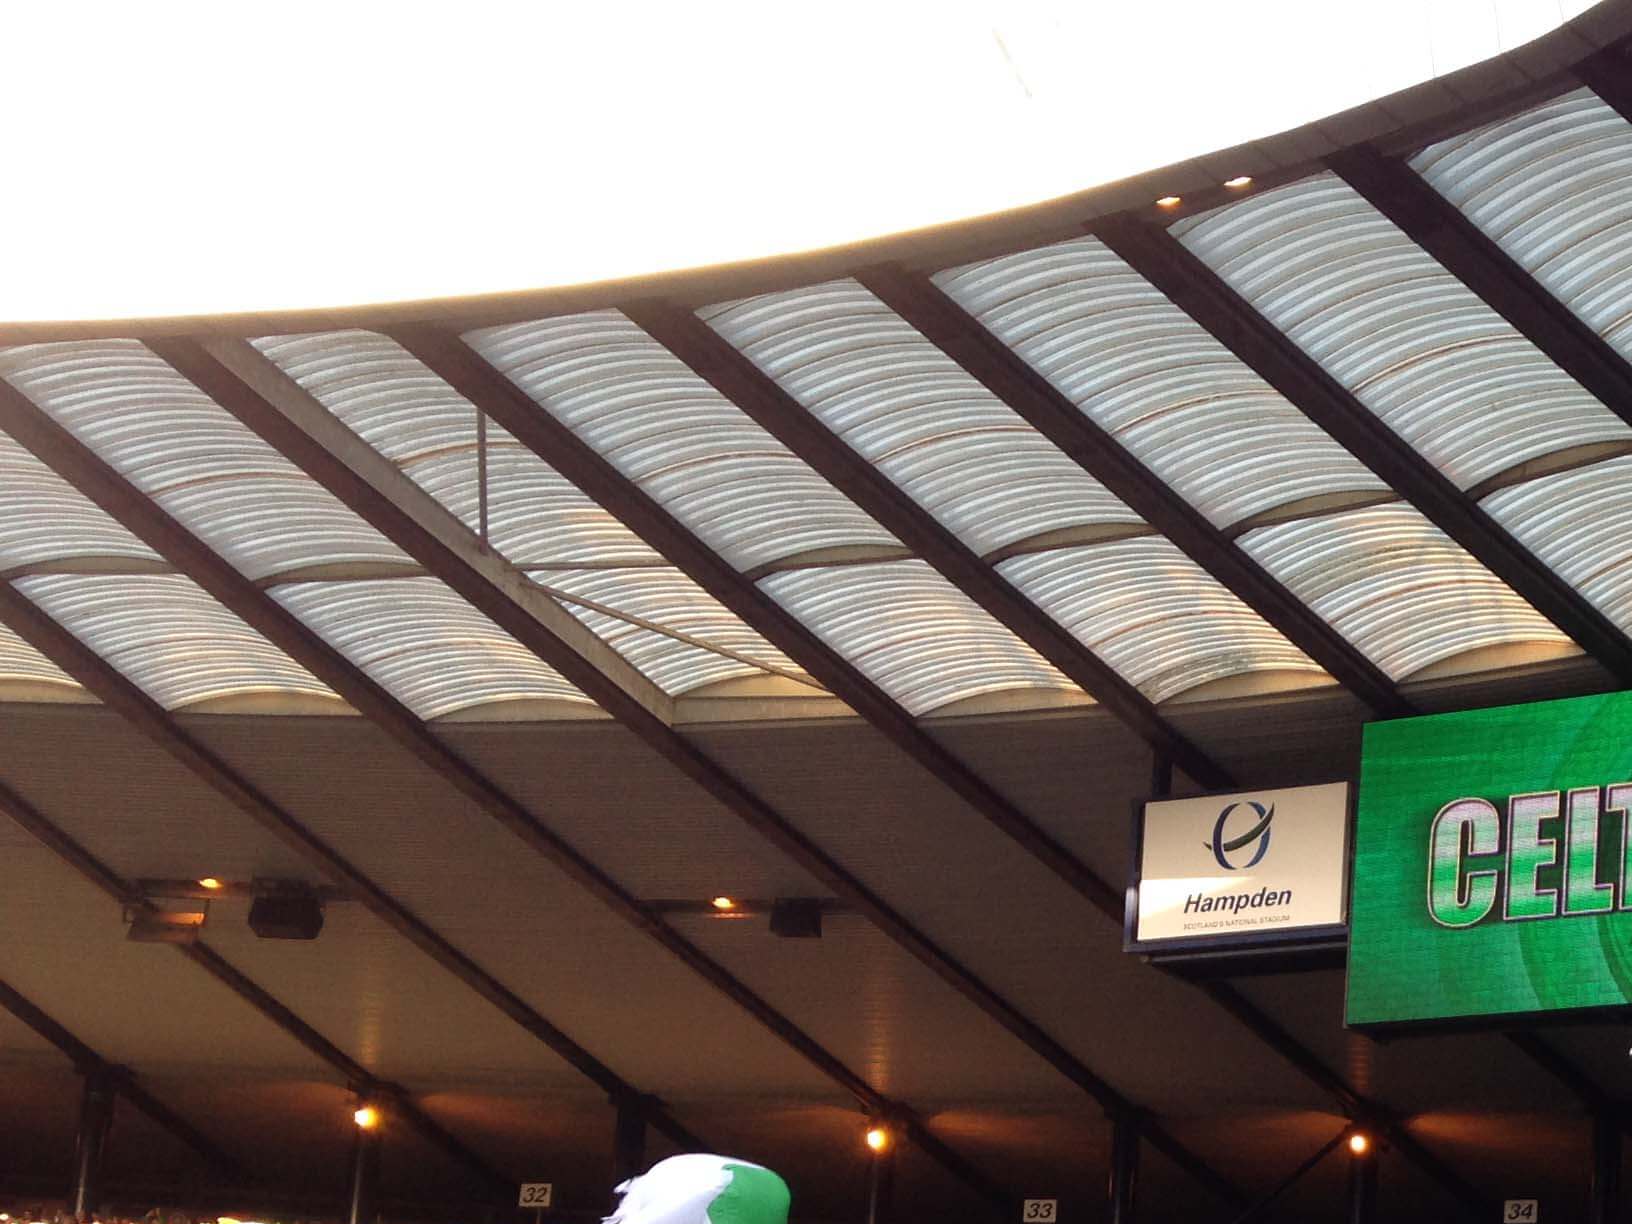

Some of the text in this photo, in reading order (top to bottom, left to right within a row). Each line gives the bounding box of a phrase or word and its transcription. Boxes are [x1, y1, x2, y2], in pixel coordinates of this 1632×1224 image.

[1183, 887, 1292, 914] Hampden
[1225, 917, 1259, 928] NATIONAL
[1259, 914, 1290, 925] STADIUM
[522, 1186, 547, 1204] 32
[1027, 1202, 1053, 1219] 33
[1507, 1203, 1534, 1220] 34
